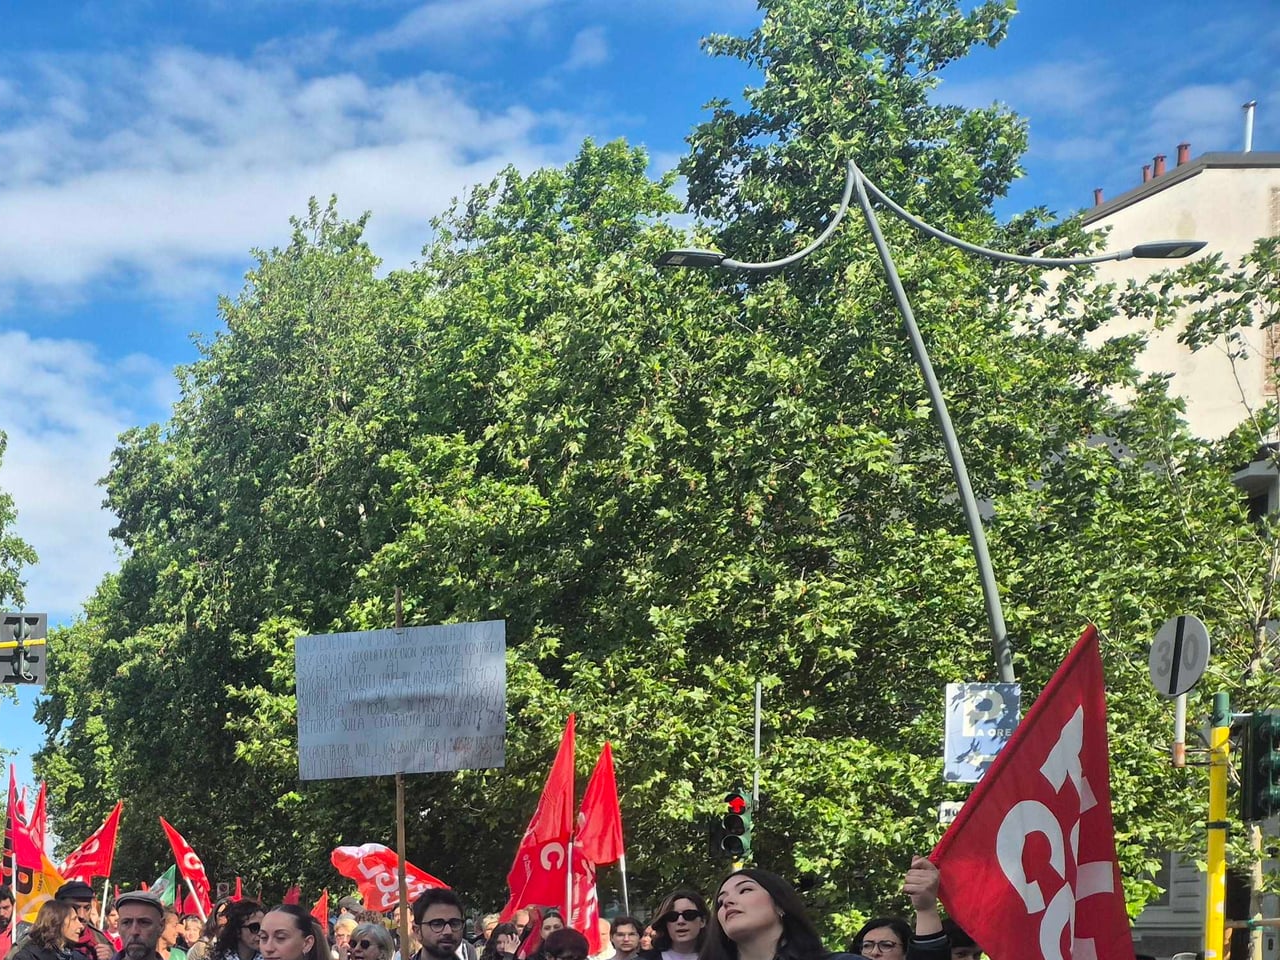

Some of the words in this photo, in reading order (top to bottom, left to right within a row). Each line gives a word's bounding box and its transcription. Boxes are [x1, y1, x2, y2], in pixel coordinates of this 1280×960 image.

[298, 660, 365, 679] SVENDITA
[386, 658, 398, 672] AI
[420, 651, 482, 670] PRIVATI
[1157, 632, 1200, 677] 30
[962, 689, 1004, 737] P
[976, 728, 985, 737] A
[987, 728, 1013, 738] ORE
